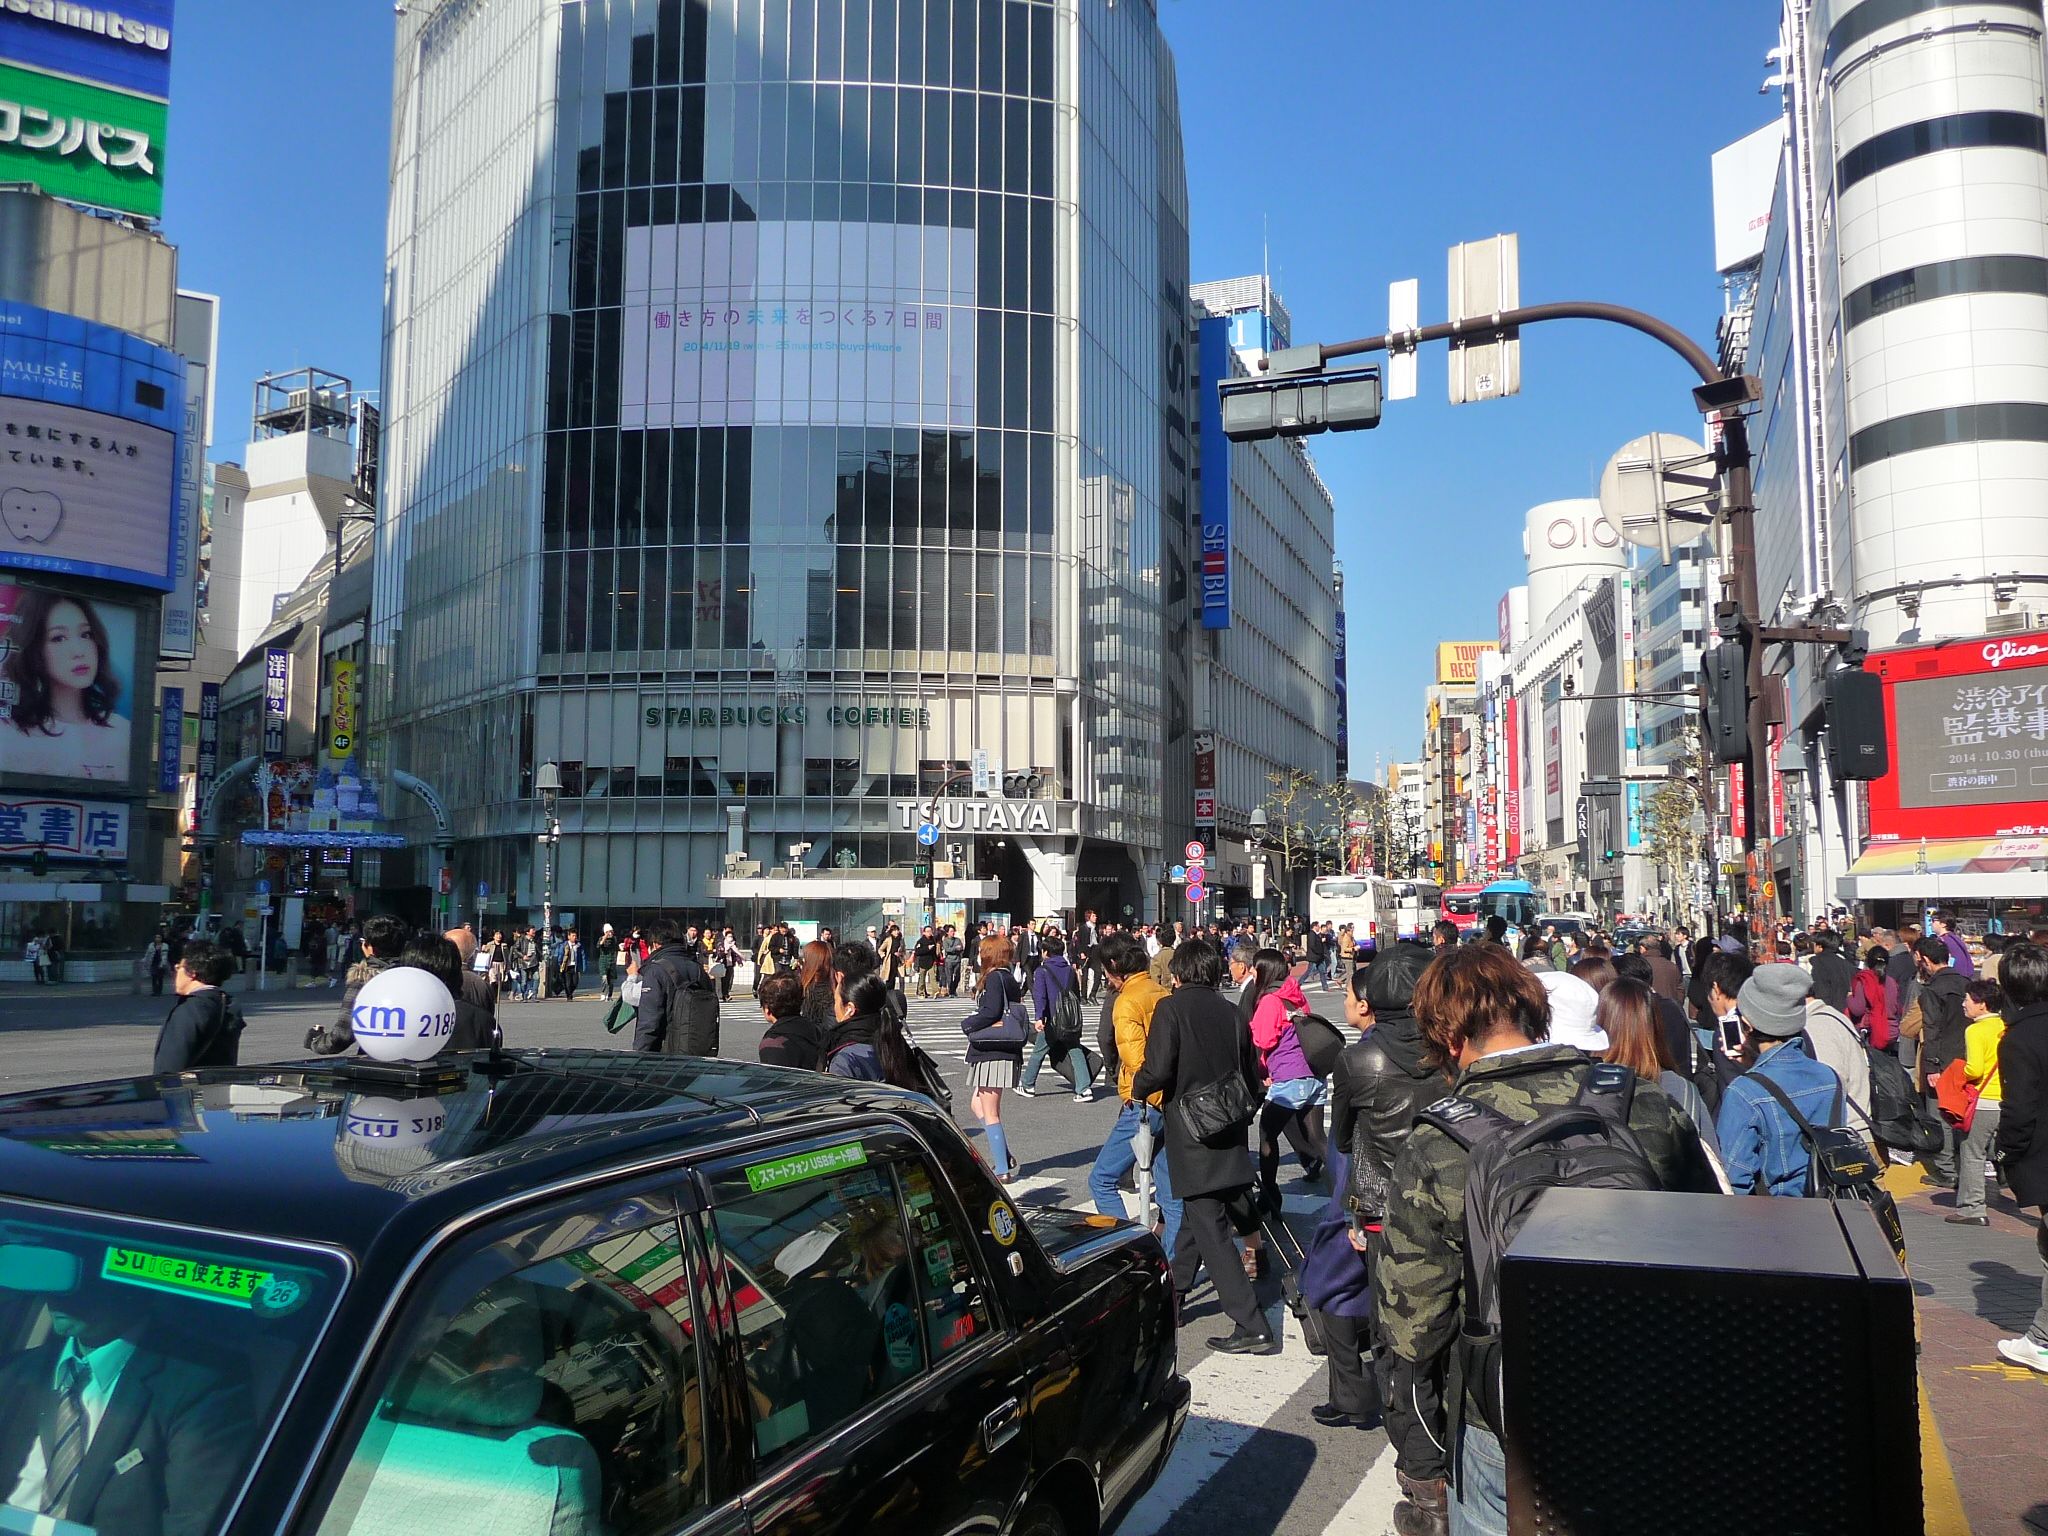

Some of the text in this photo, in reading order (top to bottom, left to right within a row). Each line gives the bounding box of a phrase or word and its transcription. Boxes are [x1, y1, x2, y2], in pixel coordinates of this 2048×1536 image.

[0, 0, 169, 50] samitsu
[3, 371, 83, 391] PLATINUM
[1203, 524, 1225, 609] SEIBU
[1983, 641, 2048, 667] Glico
[265, 654, 286, 753] 洋服の青山
[646, 706, 931, 727] STARBUCKS COFFEE
[198, 695, 218, 800] 洋服の青山
[335, 737, 349, 748] 4F
[1474, 714, 1483, 767] KARAOKE
[897, 801, 1050, 829] TSUTAYA
[1198, 801, 1211, 815] 本
[1577, 804, 1588, 838] ZARA
[0, 804, 119, 847] 堂書店
[758, 1160, 808, 1183] スマートフォン
[271, 1287, 292, 1303] 26
